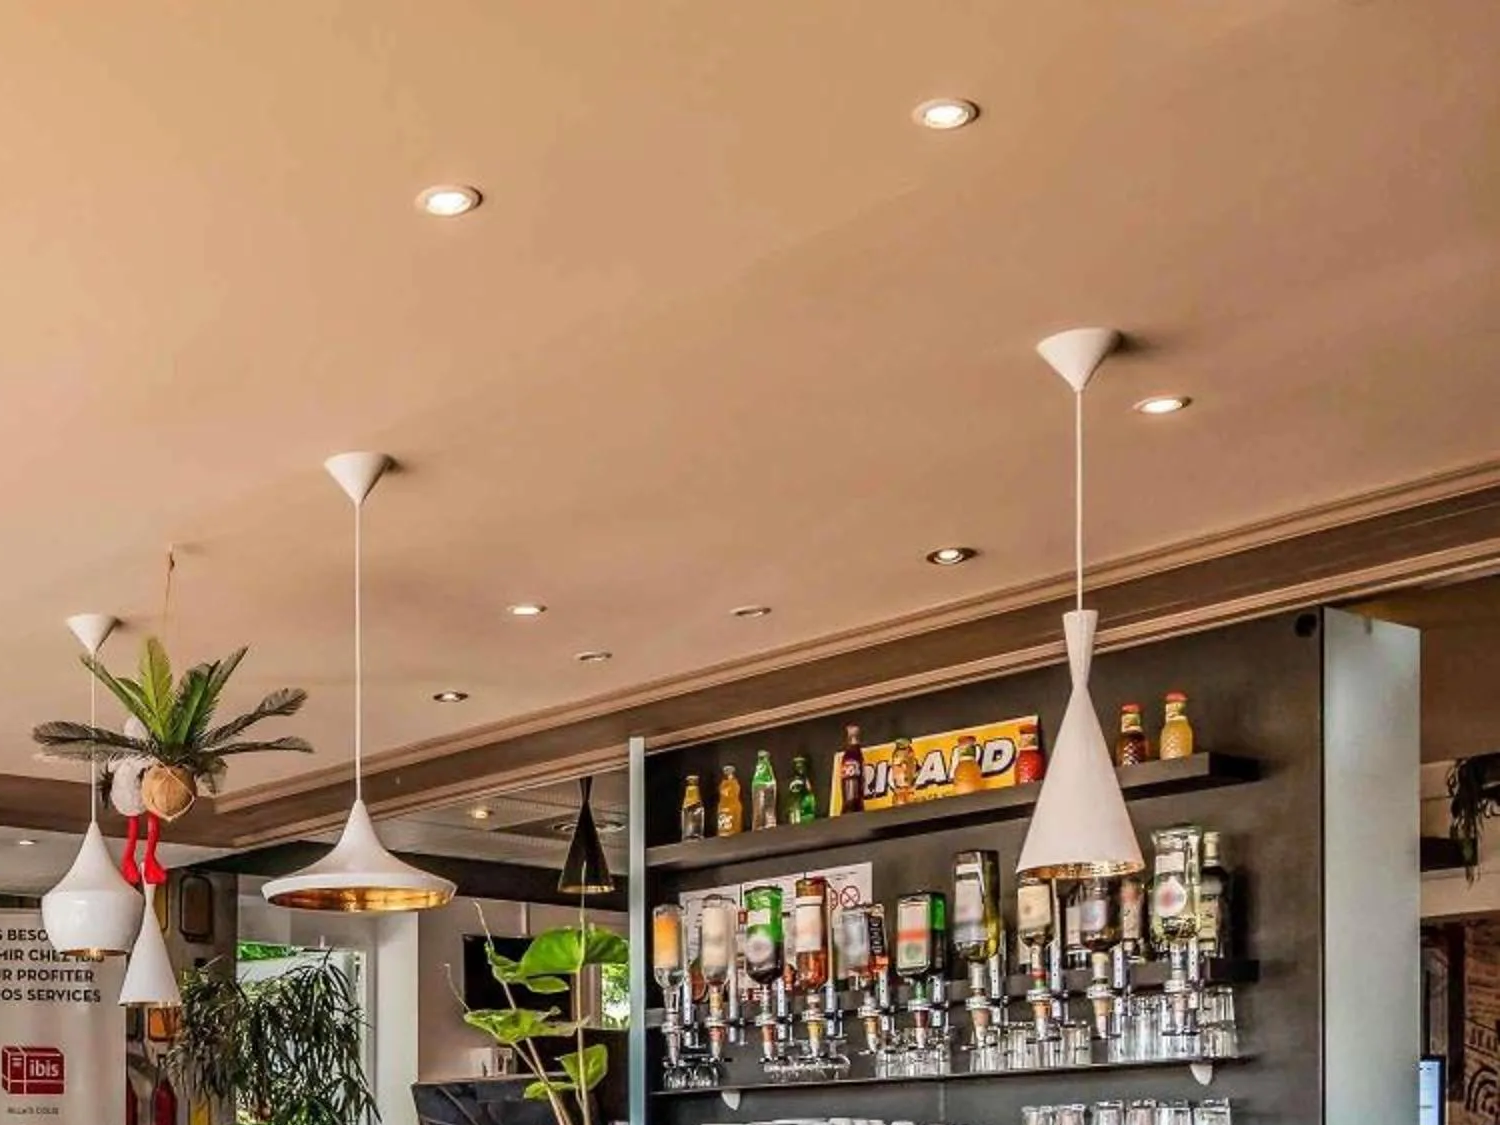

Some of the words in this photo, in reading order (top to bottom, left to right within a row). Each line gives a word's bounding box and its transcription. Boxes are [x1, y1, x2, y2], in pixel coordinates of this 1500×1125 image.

[7, 929, 49, 942] BESO
[17, 969, 95, 982] PROFITER
[27, 988, 101, 1002] SERVICES
[30, 1060, 60, 1077] ibis
